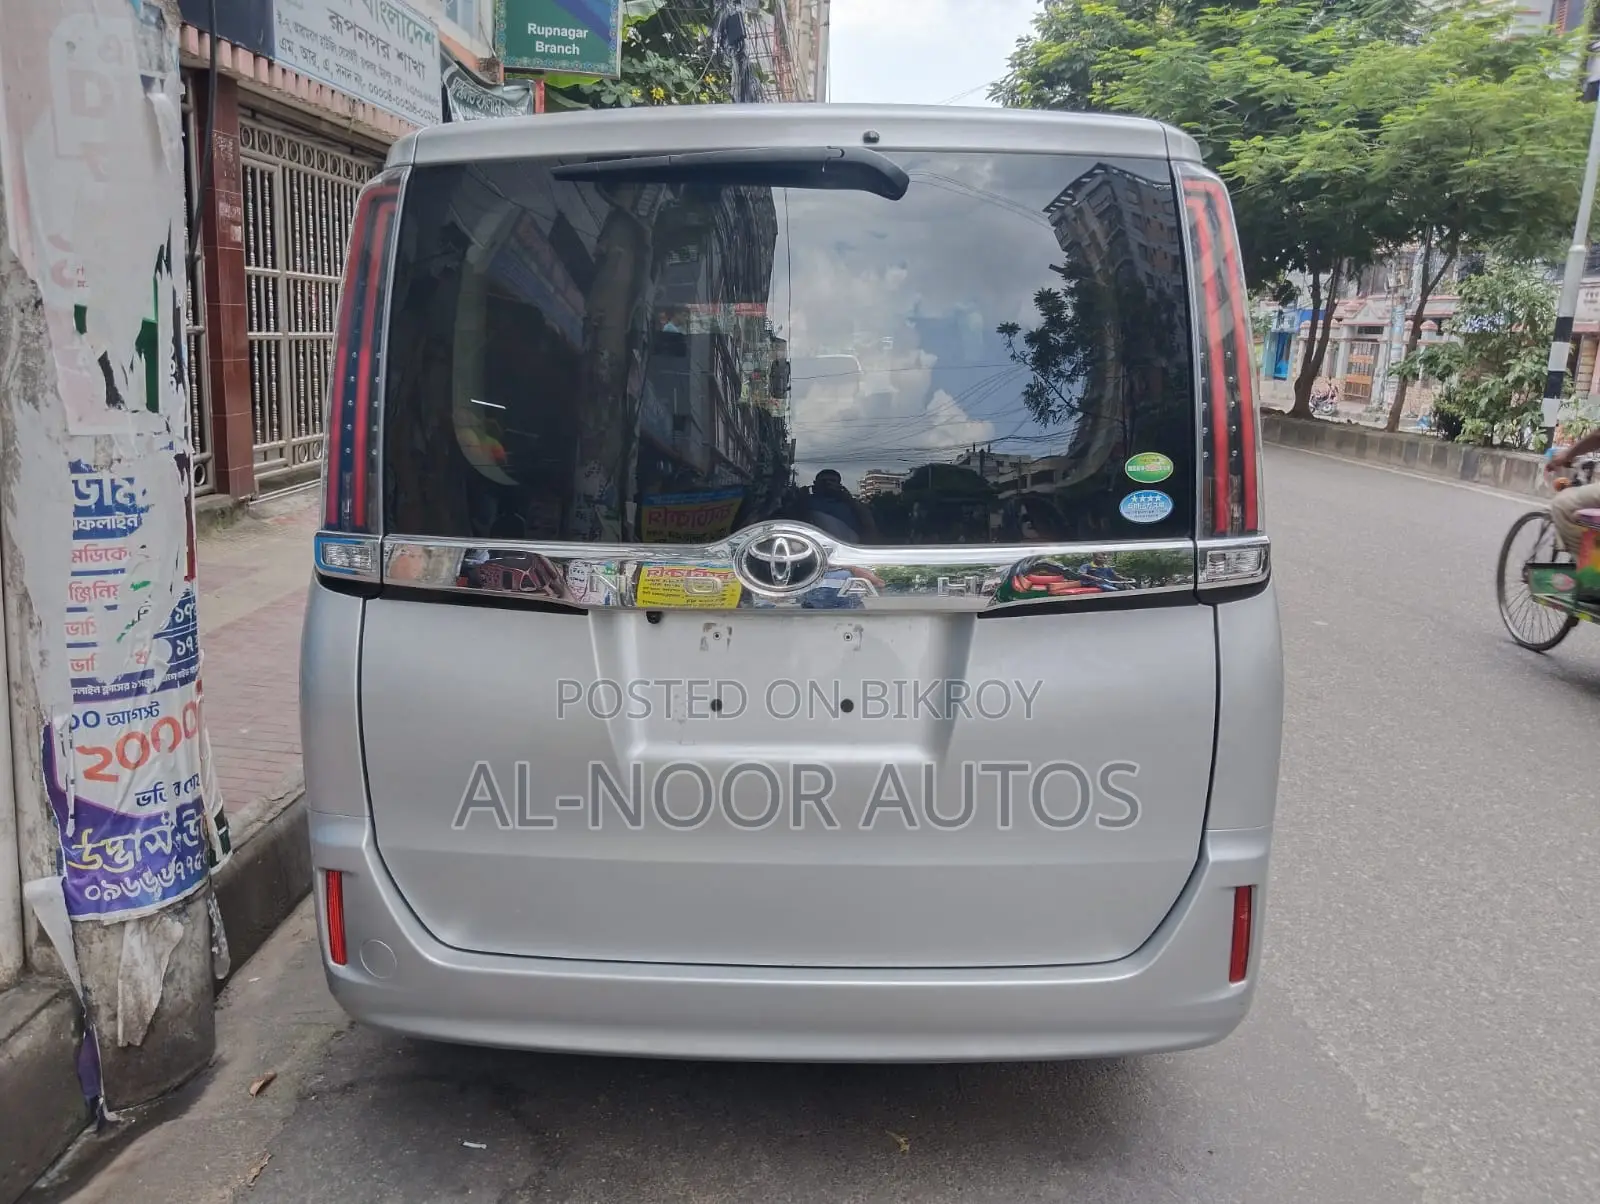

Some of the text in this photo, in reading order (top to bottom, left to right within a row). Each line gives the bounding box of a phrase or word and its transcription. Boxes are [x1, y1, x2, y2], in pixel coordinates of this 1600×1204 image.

[528, 22, 589, 40] Rupnagar
[327, 7, 426, 80] রূপনগর শাখা
[535, 41, 580, 56] Branch
[106, 701, 160, 726] আগস্ট
